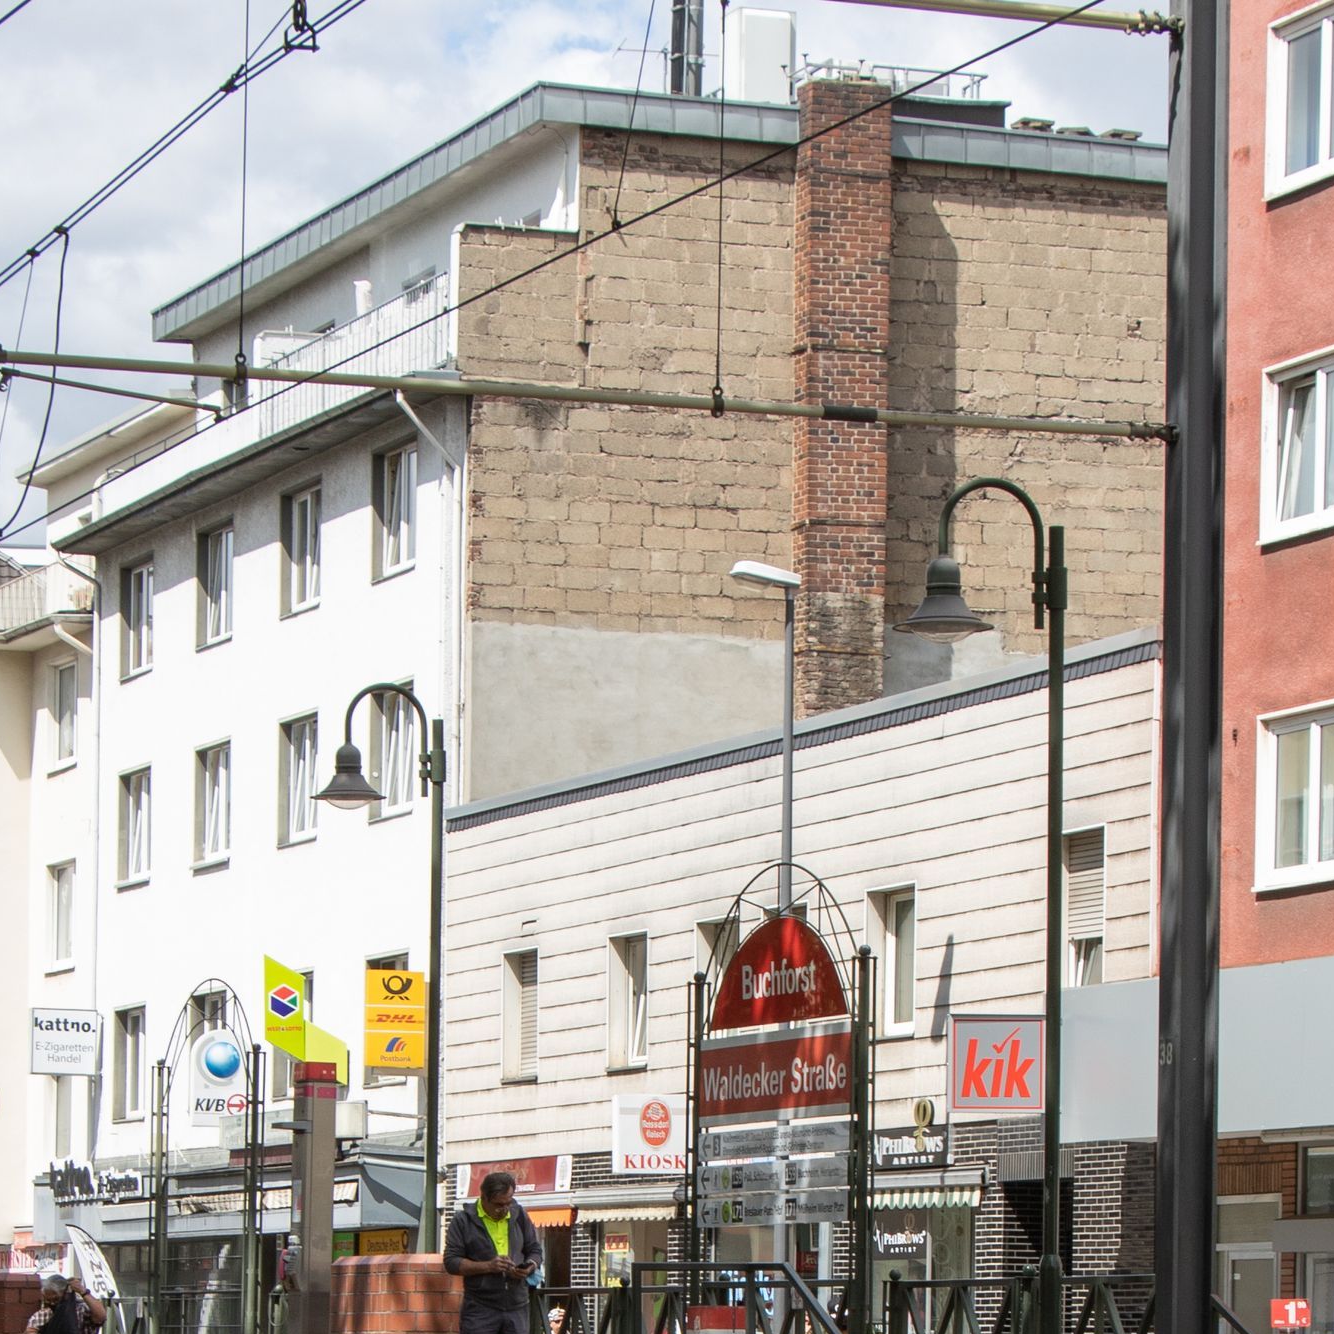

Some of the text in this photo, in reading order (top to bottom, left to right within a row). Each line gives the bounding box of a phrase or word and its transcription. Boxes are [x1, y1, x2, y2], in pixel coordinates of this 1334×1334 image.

[741, 958, 816, 1000] Buchforst
[376, 1014, 416, 1023] DHL
[35, 1041, 94, 1053] E-Zigaretten
[48, 1054, 82, 1063] Handel
[380, 1054, 411, 1062] Postbank
[960, 1027, 1035, 1098] kik
[703, 1053, 847, 1102] Waldecker Straße
[194, 1098, 226, 1112] KVB
[624, 1154, 687, 1170] KIOSK
[892, 1155, 935, 1165] ARTIST
